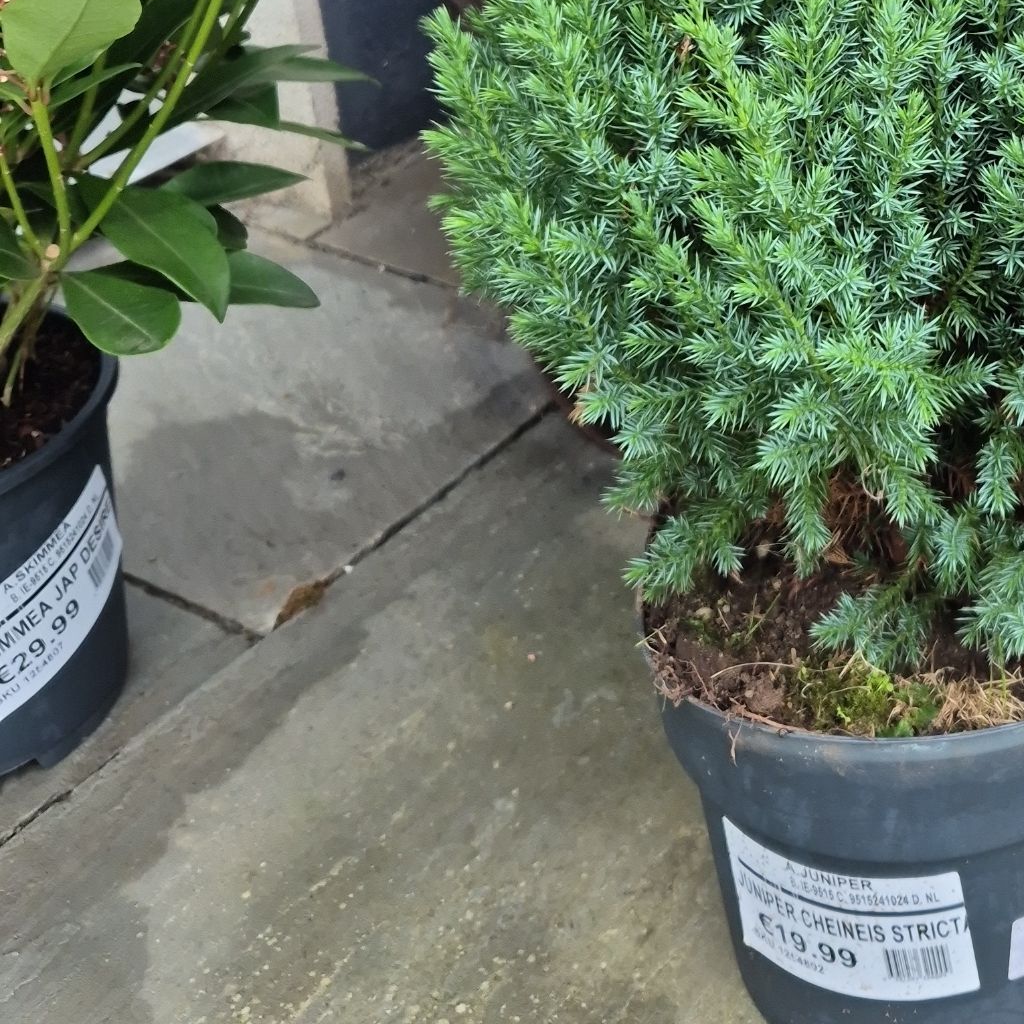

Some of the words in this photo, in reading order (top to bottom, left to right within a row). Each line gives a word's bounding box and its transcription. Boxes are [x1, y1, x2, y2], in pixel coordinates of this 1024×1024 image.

[0, 601, 53, 656] MMEA
[55, 563, 79, 601] JAP
[0, 599, 80, 685] €29.99
[739, 871, 798, 922] JUNIPER
[801, 909, 886, 944] CHEINEIS
[926, 892, 940, 904] NL
[758, 912, 857, 969] €19.99
